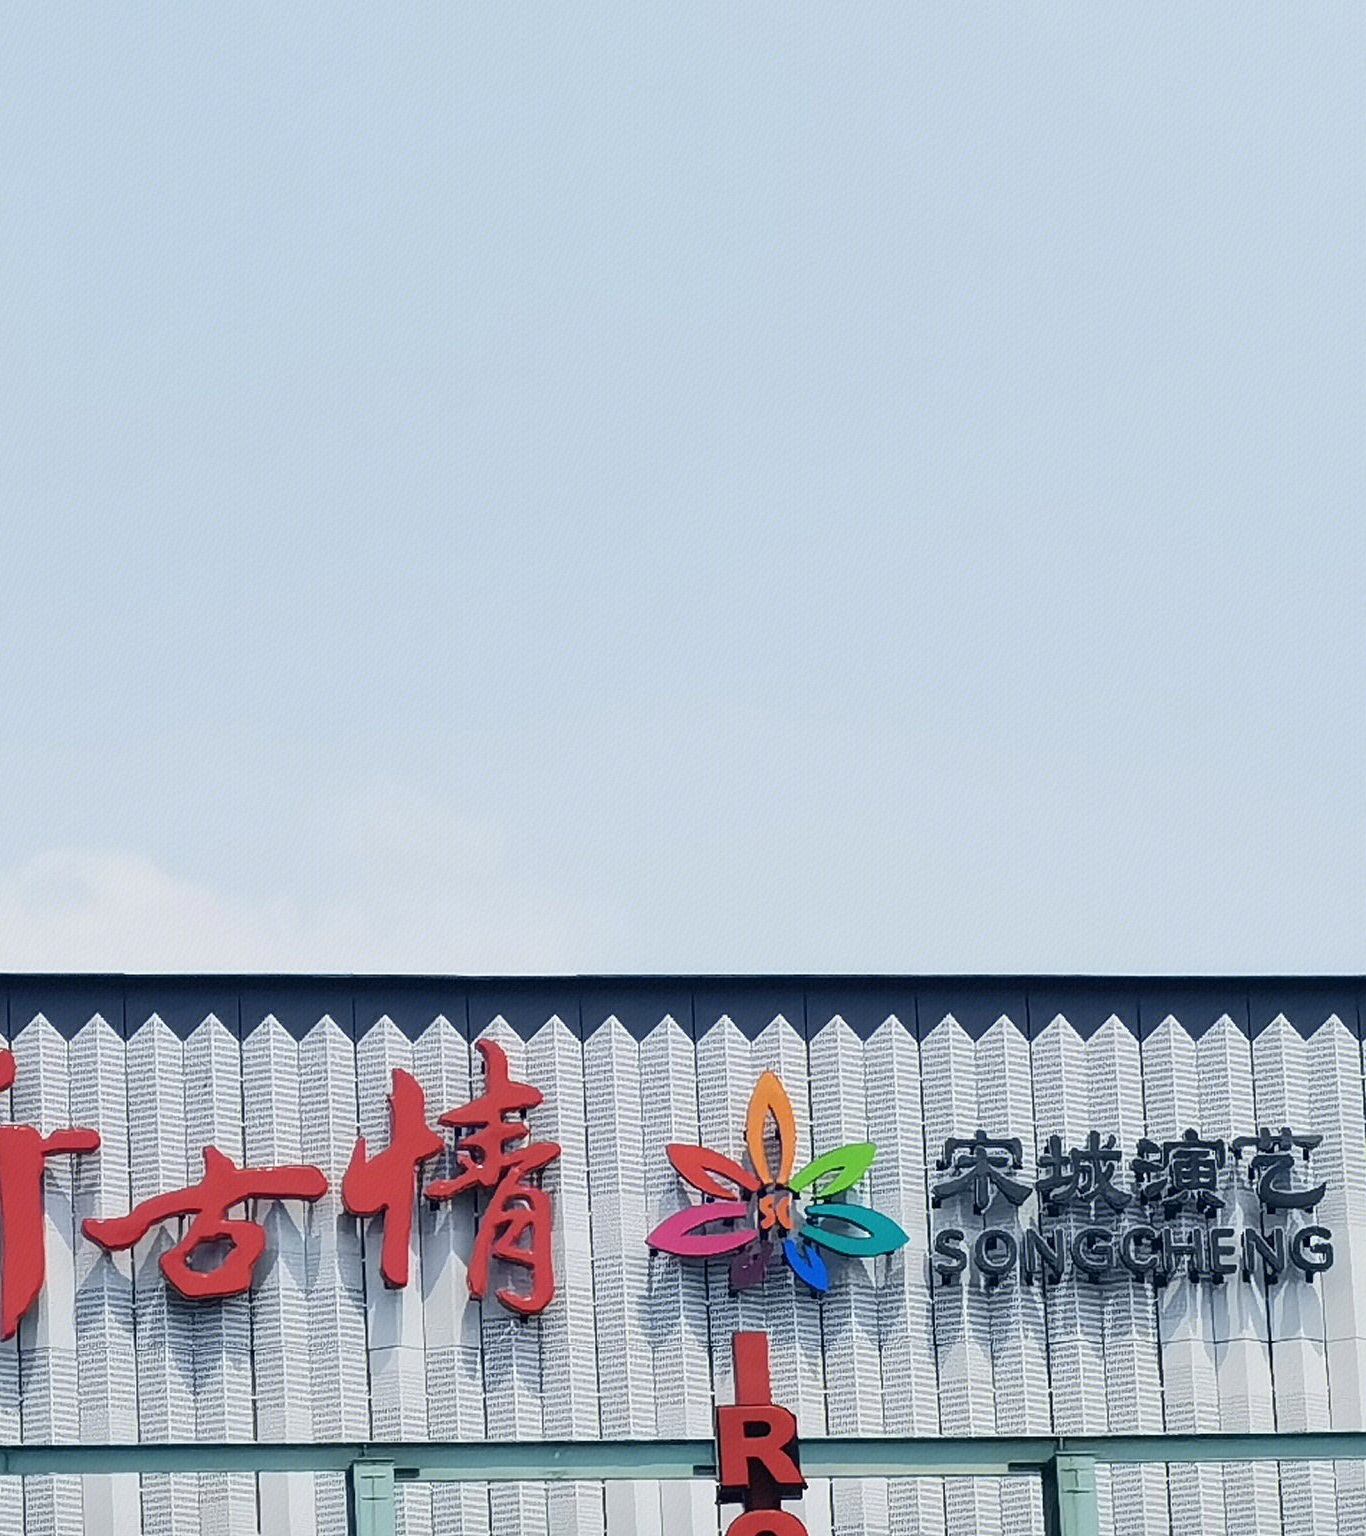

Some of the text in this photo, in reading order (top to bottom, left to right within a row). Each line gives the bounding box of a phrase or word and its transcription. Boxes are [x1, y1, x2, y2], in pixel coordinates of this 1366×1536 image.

[932, 1128, 1328, 1211] 宋城演艺
[934, 1225, 1335, 1274] SONGCHENG
